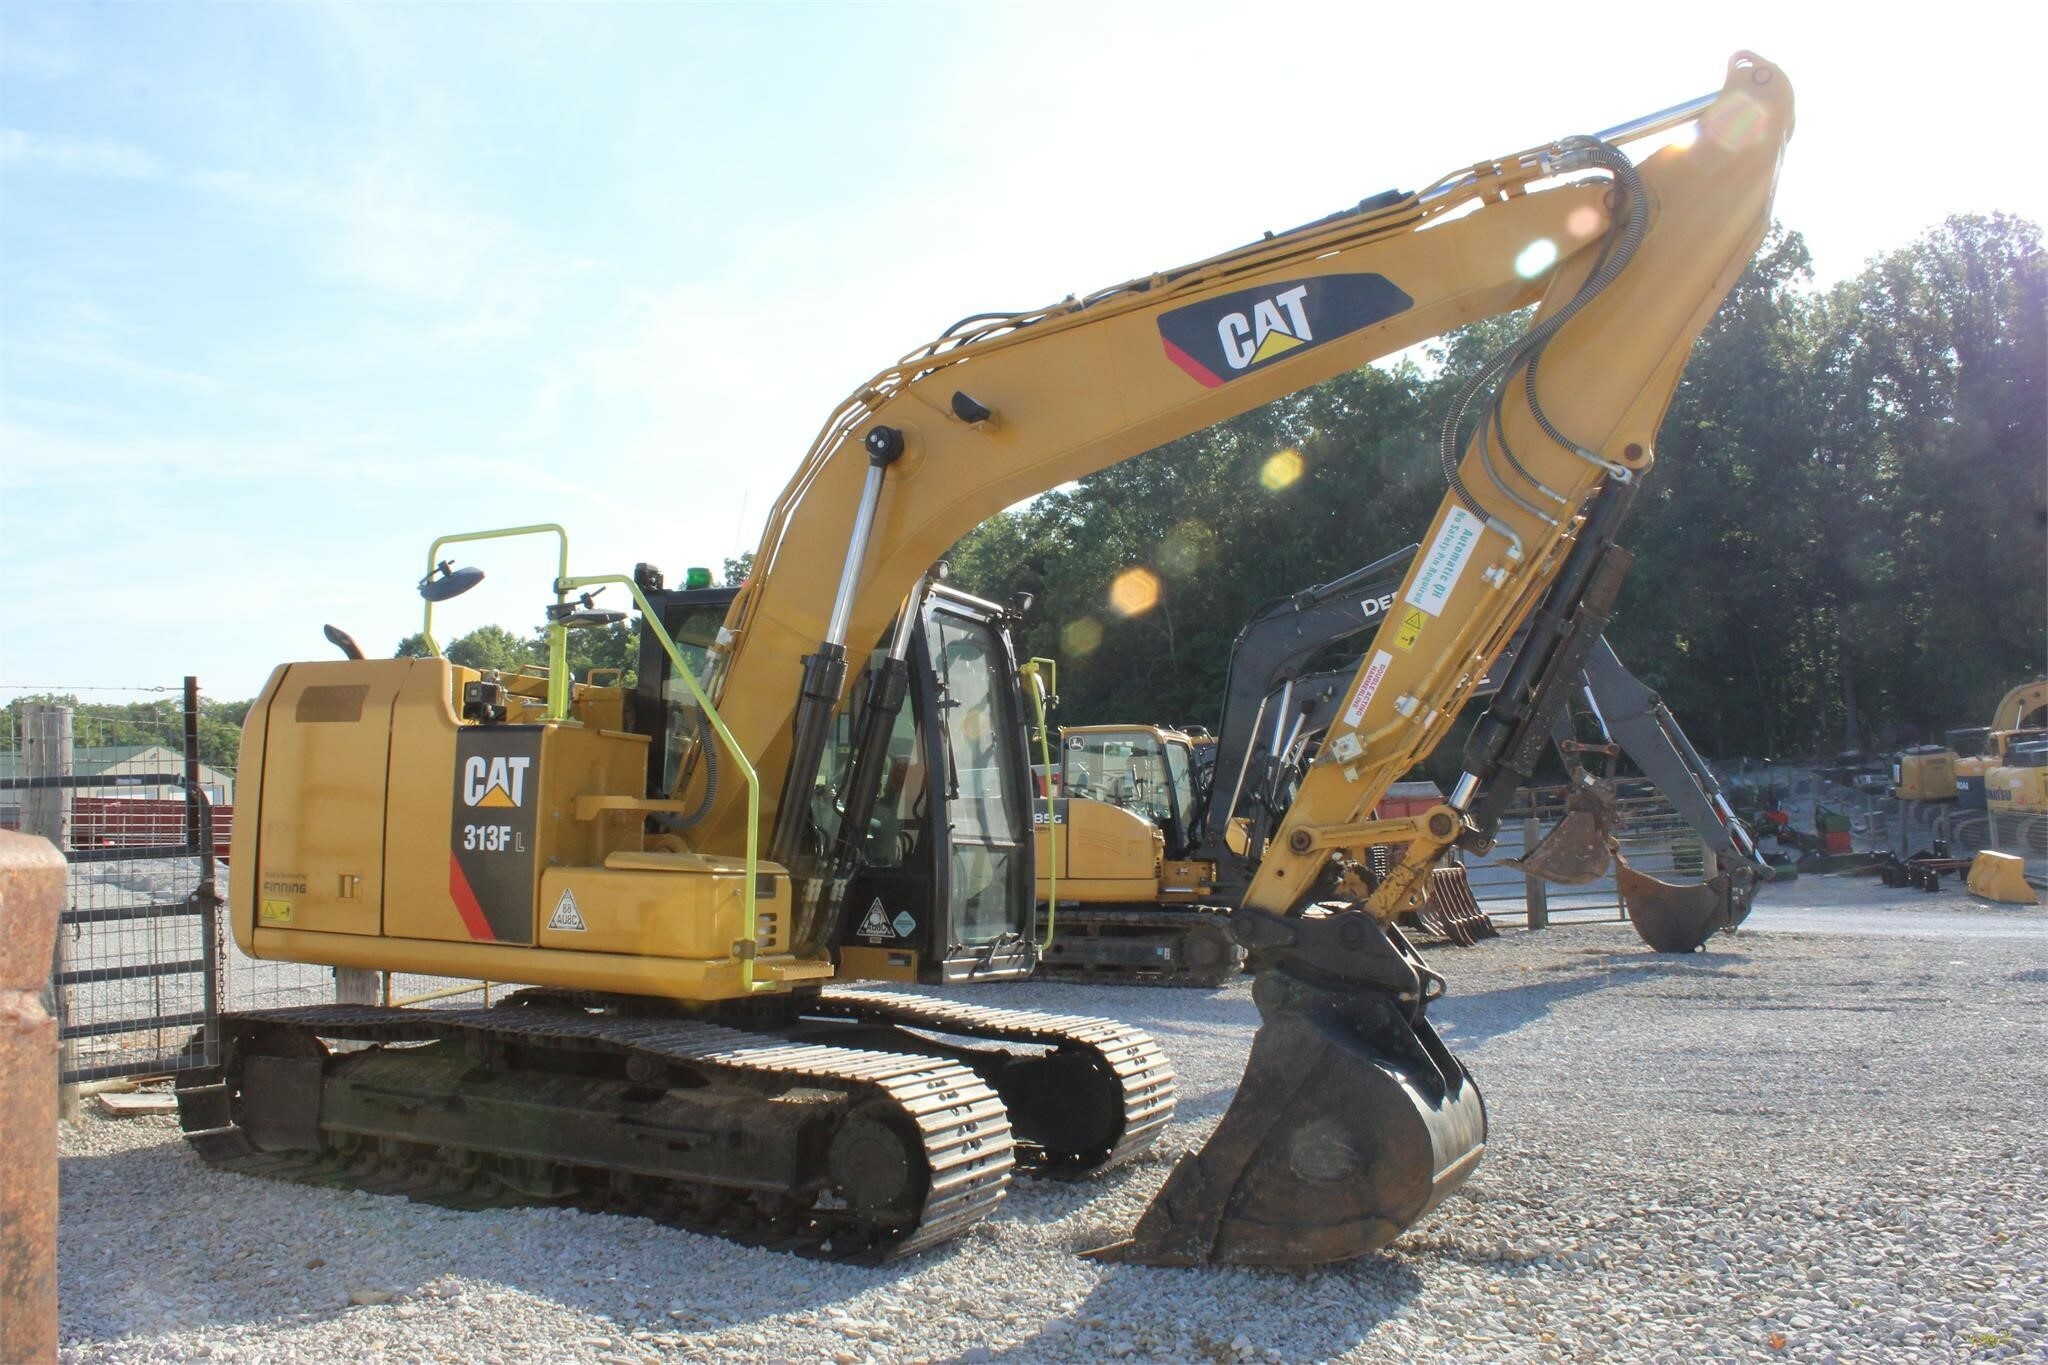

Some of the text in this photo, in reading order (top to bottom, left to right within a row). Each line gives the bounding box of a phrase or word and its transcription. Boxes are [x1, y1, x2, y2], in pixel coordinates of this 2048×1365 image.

[1218, 285, 1312, 369] CAT
[1432, 552, 1445, 566] Pin
[1438, 523, 1460, 552] Safety
[1440, 528, 1473, 581] Automatic
[1352, 665, 1378, 709] HAMMERLINE
[1355, 663, 1386, 717] DOUBLE ACTING
[463, 755, 530, 807] CAT
[463, 824, 525, 853] 313F L
